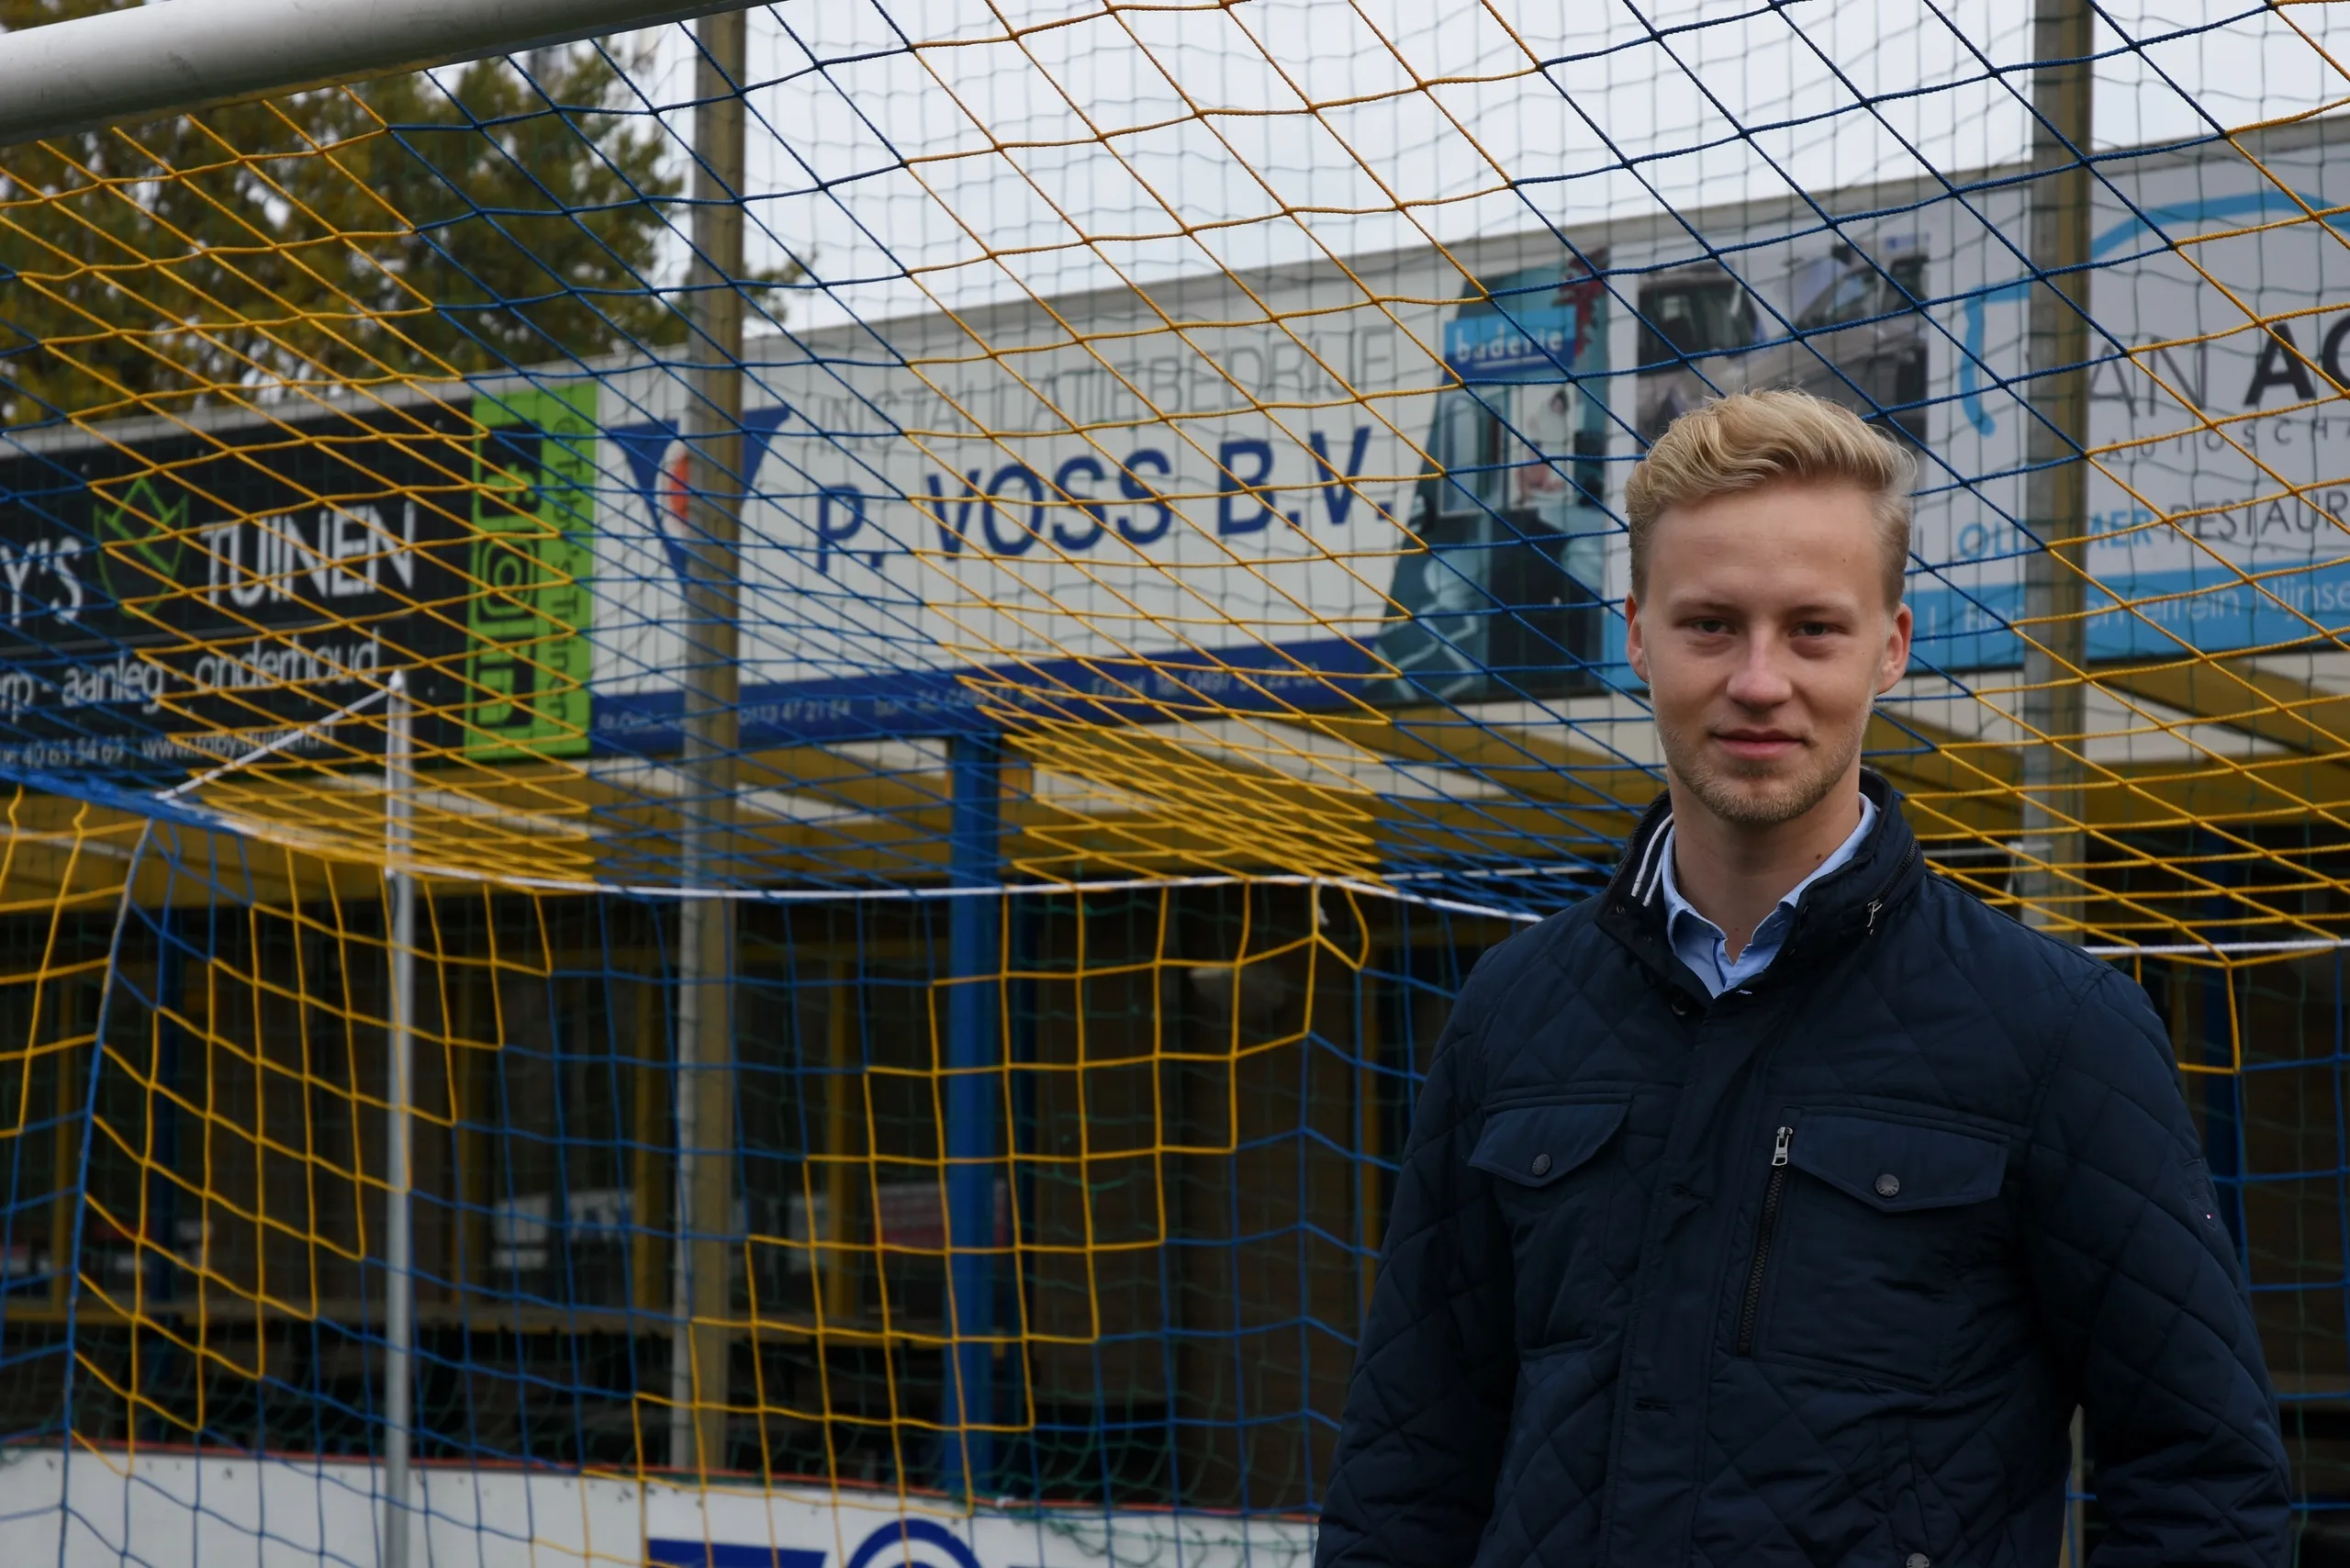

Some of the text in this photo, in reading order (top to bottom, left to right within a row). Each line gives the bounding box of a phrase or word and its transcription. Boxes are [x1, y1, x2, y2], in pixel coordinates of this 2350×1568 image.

[819, 323, 1396, 456] INSTALLATIEBEDRIJF
[1454, 323, 1563, 363] baderie
[2105, 415, 2350, 462] AUTOSCH
[814, 425, 1393, 575] P. VOSS B.V.
[199, 500, 416, 609] TUINEN
[62, 647, 163, 715] aanleg
[194, 627, 382, 693] onderhoud
